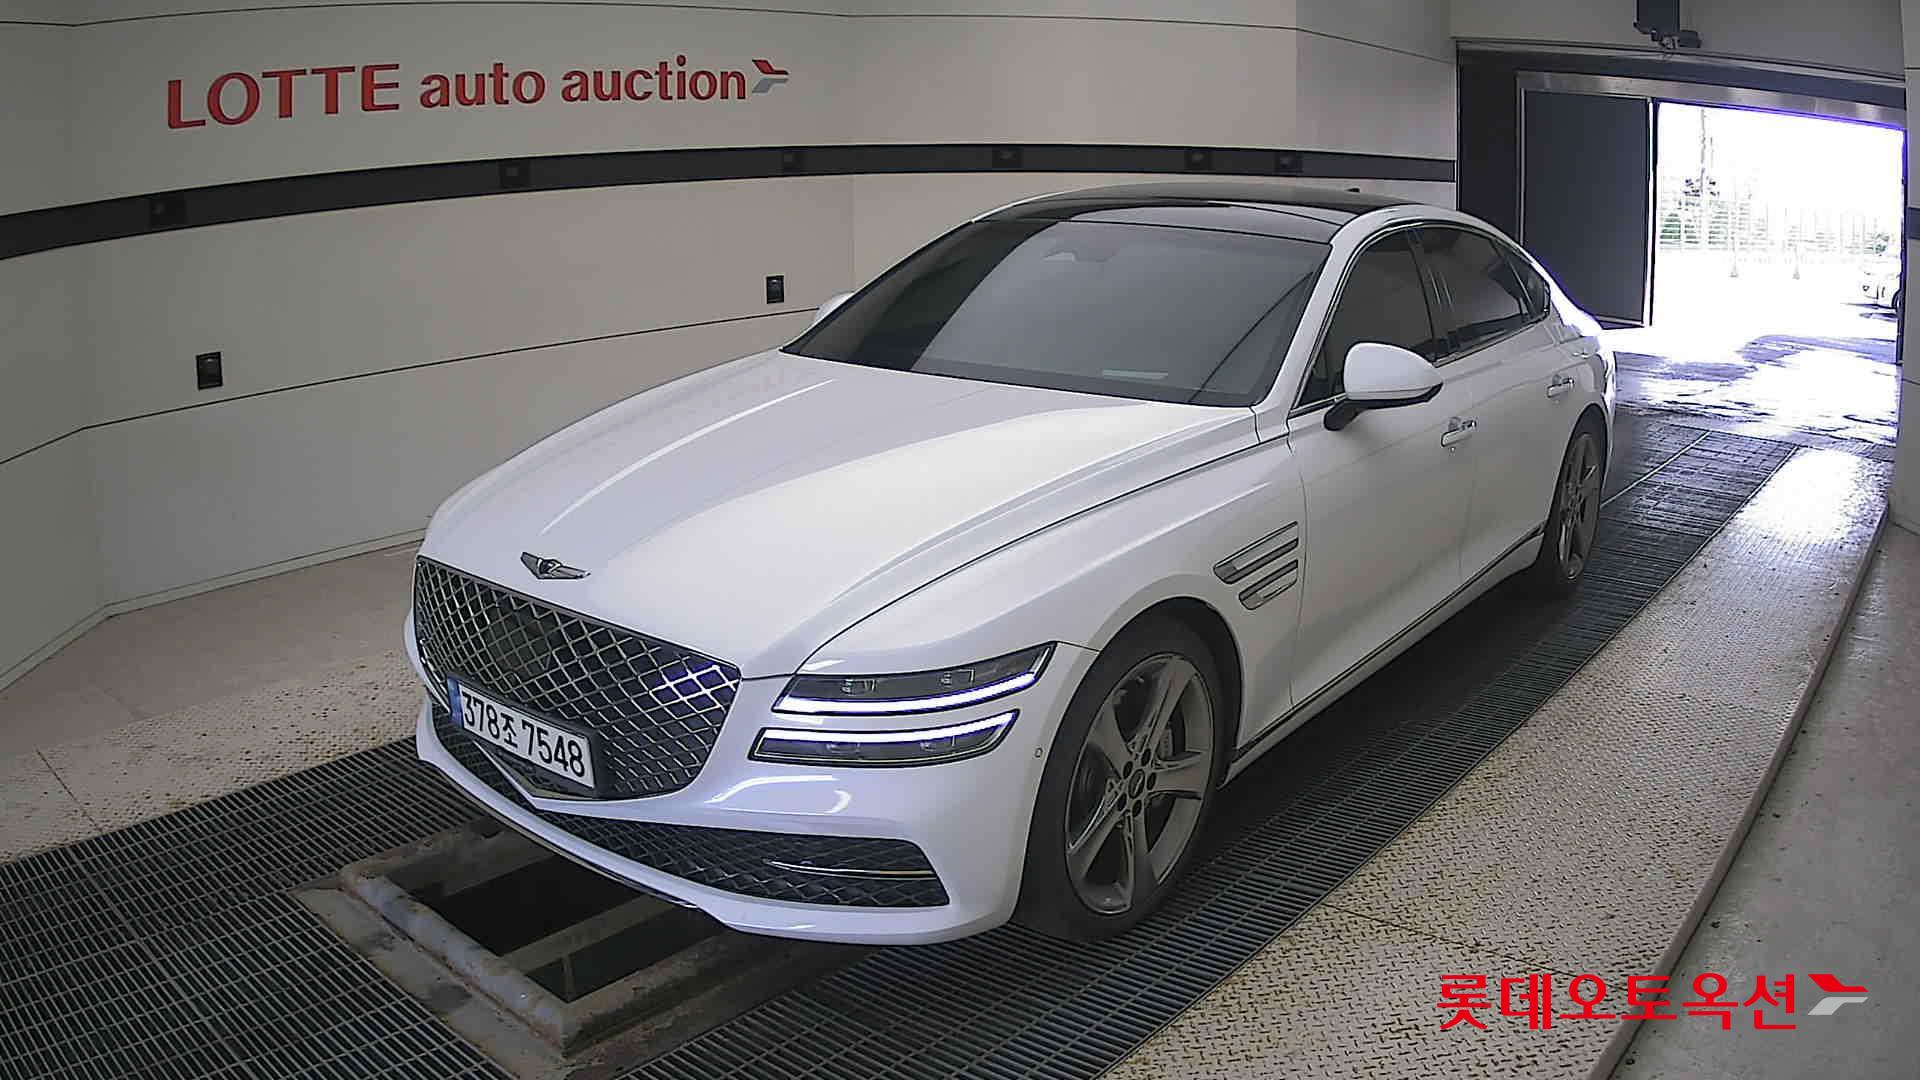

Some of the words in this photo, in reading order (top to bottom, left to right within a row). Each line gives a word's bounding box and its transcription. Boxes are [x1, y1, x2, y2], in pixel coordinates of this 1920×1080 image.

[167, 63, 400, 129] LOTTE
[419, 62, 546, 108] auto
[561, 54, 746, 101] auction
